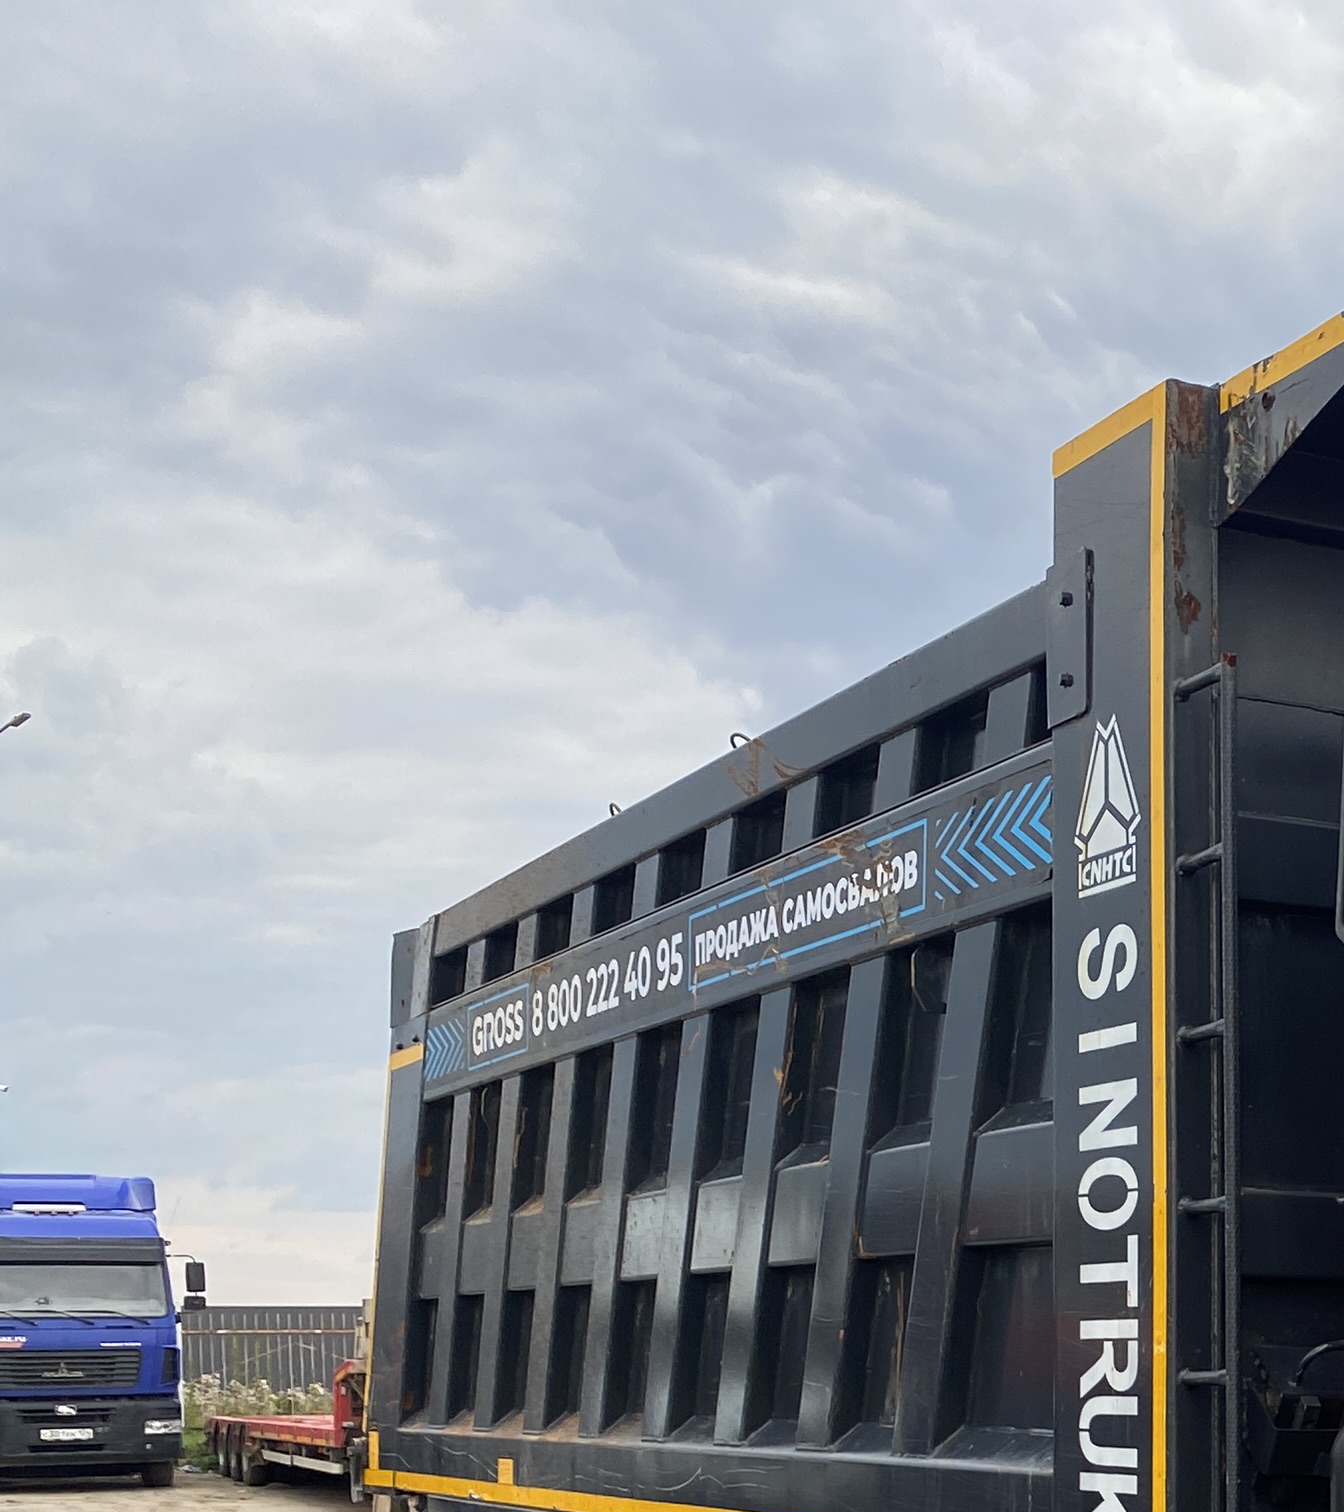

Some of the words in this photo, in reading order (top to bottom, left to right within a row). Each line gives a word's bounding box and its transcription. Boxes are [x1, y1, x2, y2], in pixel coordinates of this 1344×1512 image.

[1082, 847, 1133, 887] CNHTC
[694, 905, 779, 967] ПРОДАЖА
[472, 999, 524, 1057] GROSS
[531, 989, 543, 1037] 8
[546, 974, 582, 1032] 800
[586, 958, 620, 1018] 222
[624, 945, 651, 1001] 40
[656, 931, 684, 992] 95
